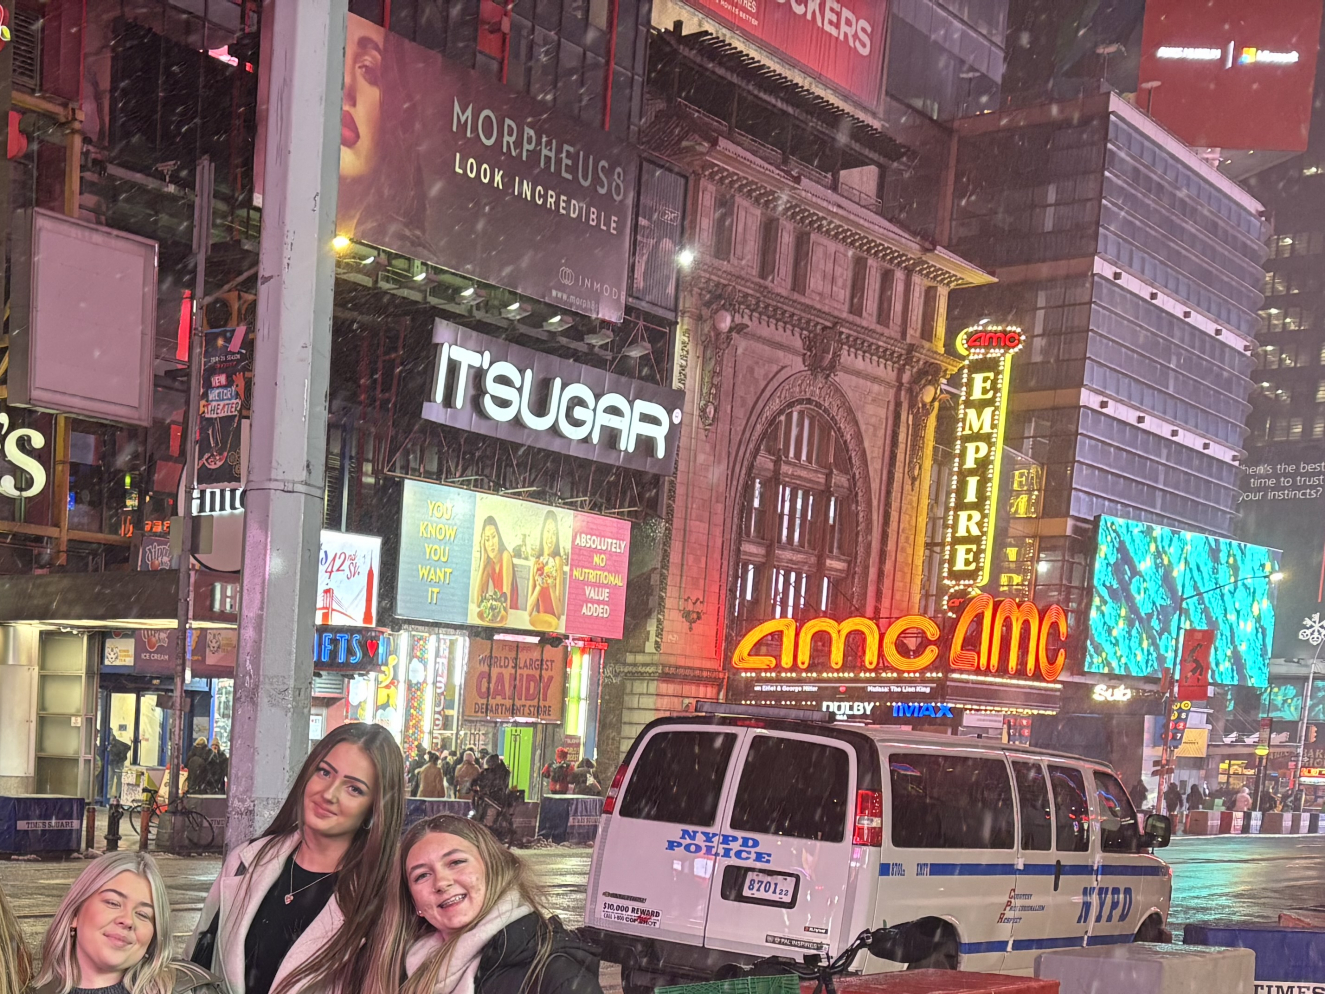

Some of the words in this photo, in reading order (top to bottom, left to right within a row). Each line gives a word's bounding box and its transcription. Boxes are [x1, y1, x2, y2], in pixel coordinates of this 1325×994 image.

[452, 95, 624, 201] MORPHEUS8
[454, 152, 504, 190] LOOK
[514, 176, 618, 234] INCREDIBLE
[579, 275, 626, 303] INMODE
[204, 401, 241, 416] THEATER
[434, 341, 670, 460] IT'SUGAR
[952, 372, 996, 571] EMPIRE
[1277, 462, 1296, 474] the
[1300, 461, 1325, 473] best
[1250, 476, 1276, 487] time
[1280, 476, 1293, 486] to
[1296, 475, 1324, 486] trust
[1267, 487, 1323, 500] instincts?
[428, 499, 454, 520] YOU
[419, 521, 457, 542] KNOW
[424, 543, 449, 562] YOU
[574, 532, 626, 554] ABSOLUTELY
[593, 553, 606, 567] NO
[418, 564, 453, 584] WANT
[572, 567, 623, 587] NUTRITIONAL
[428, 587, 440, 604] IT
[584, 585, 610, 602] VALUE
[581, 603, 610, 618] ADDED
[150, 653, 169, 661] CREAM
[478, 655, 516, 669] WORLD'S
[518, 657, 555, 671] LARGEST
[475, 670, 554, 702] CANDY
[473, 702, 526, 716] DEPARTMENT
[527, 704, 552, 717] STORE
[892, 703, 953, 718] IMAX
[679, 828, 760, 849] NYPD
[665, 839, 773, 864] POLICE
[747, 877, 779, 895] 8701
[603, 901, 630, 913] $10,000
[630, 906, 661, 918] REWARD
[1077, 886, 1133, 924] NYPD
